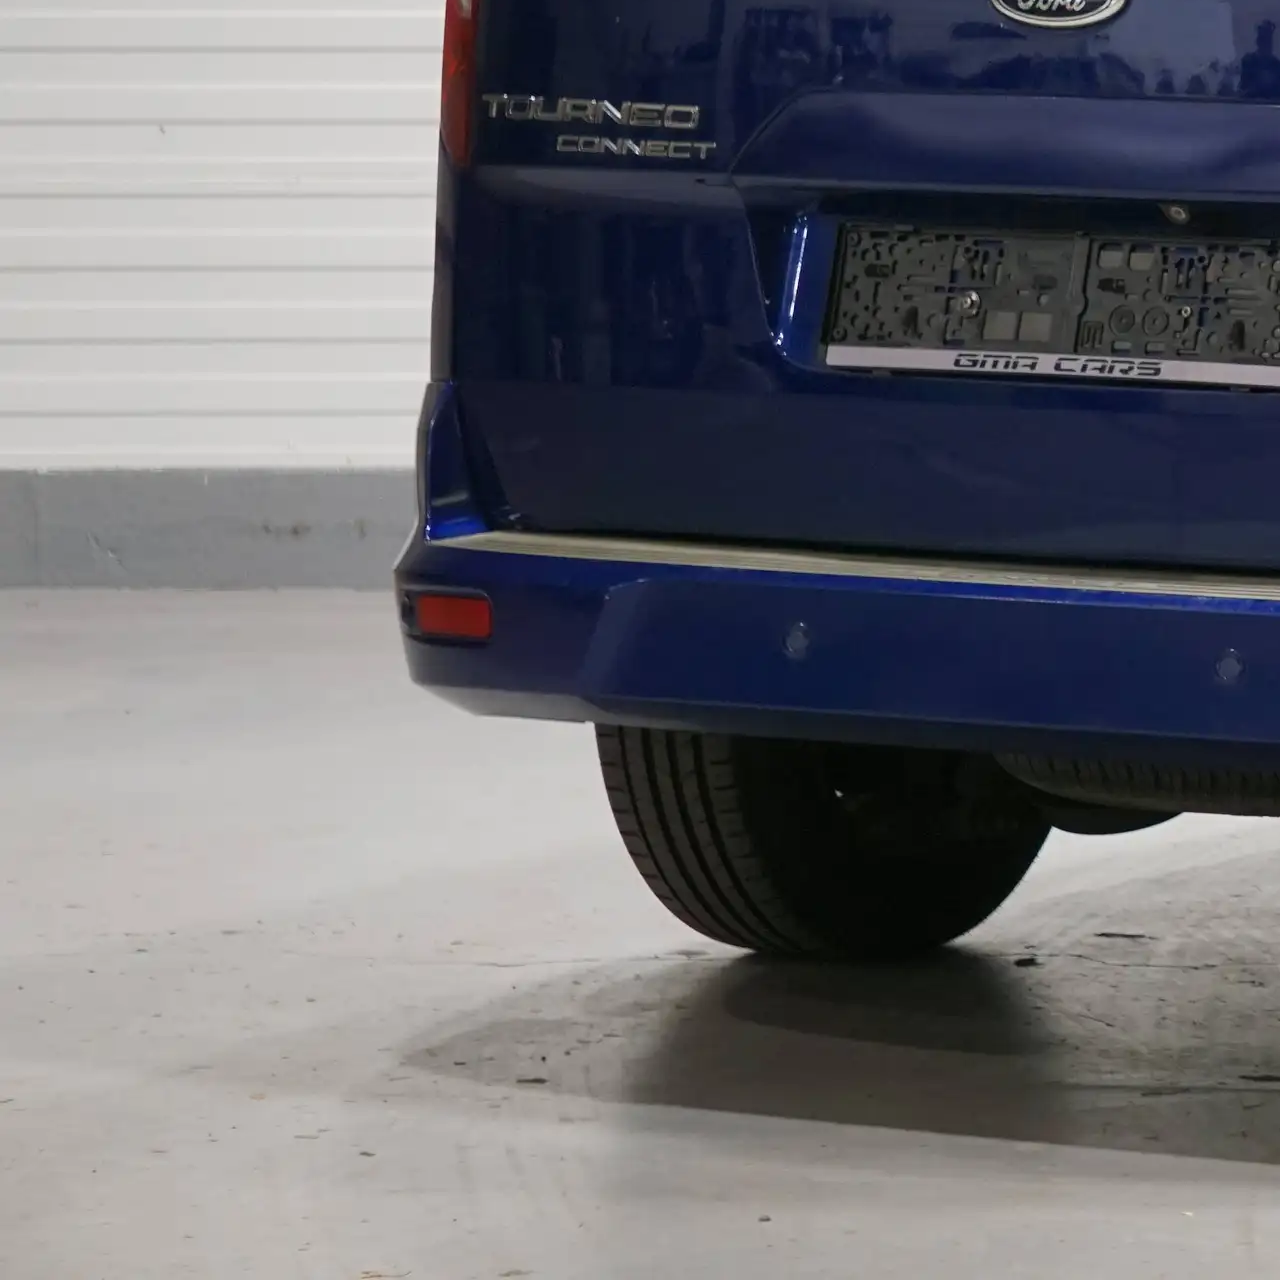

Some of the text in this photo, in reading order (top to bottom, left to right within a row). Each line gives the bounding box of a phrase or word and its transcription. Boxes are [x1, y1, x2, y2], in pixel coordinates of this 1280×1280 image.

[482, 93, 699, 129] TOURNEO
[557, 135, 716, 159] CONNECT
[953, 352, 1162, 376] GMA CARS
